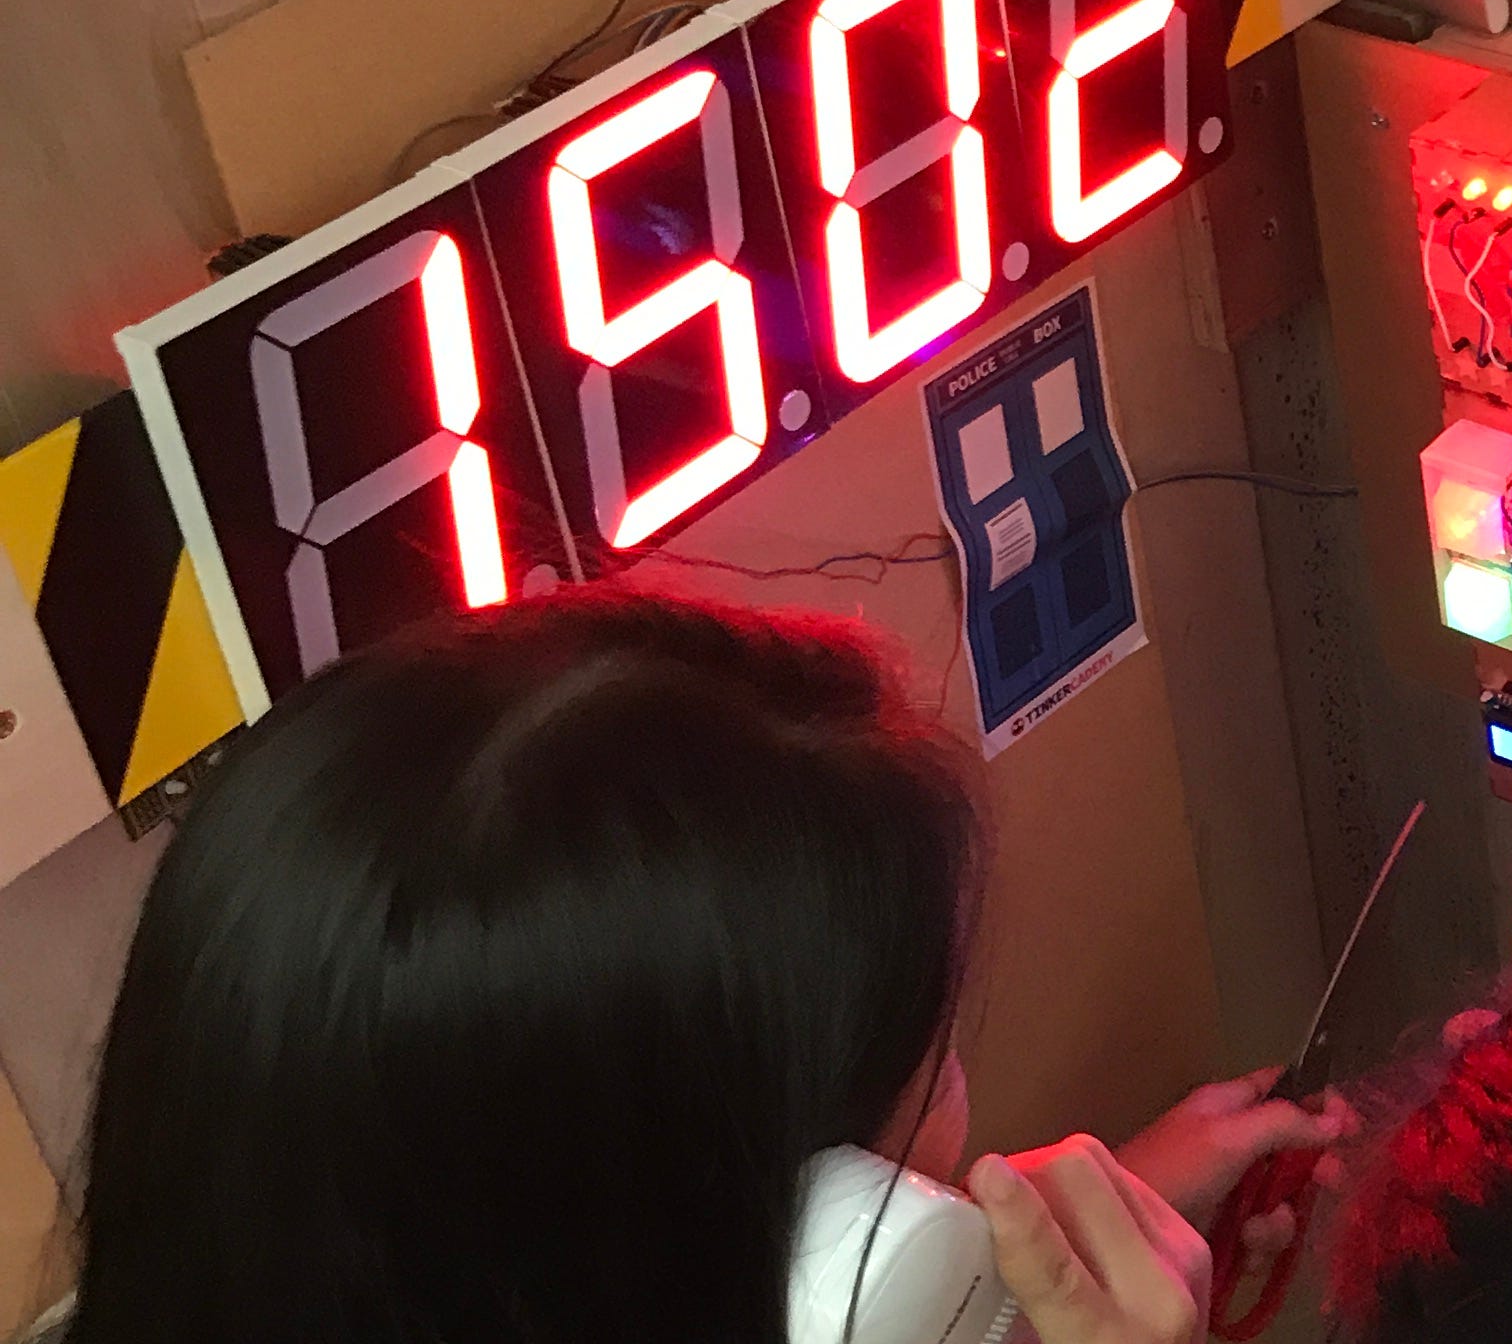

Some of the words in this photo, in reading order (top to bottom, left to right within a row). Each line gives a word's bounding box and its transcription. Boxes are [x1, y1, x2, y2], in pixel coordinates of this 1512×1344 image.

[948, 356, 998, 397] POLICE
[1033, 315, 1062, 344] BOX
[1025, 650, 1114, 724] TINKERCADEMY
